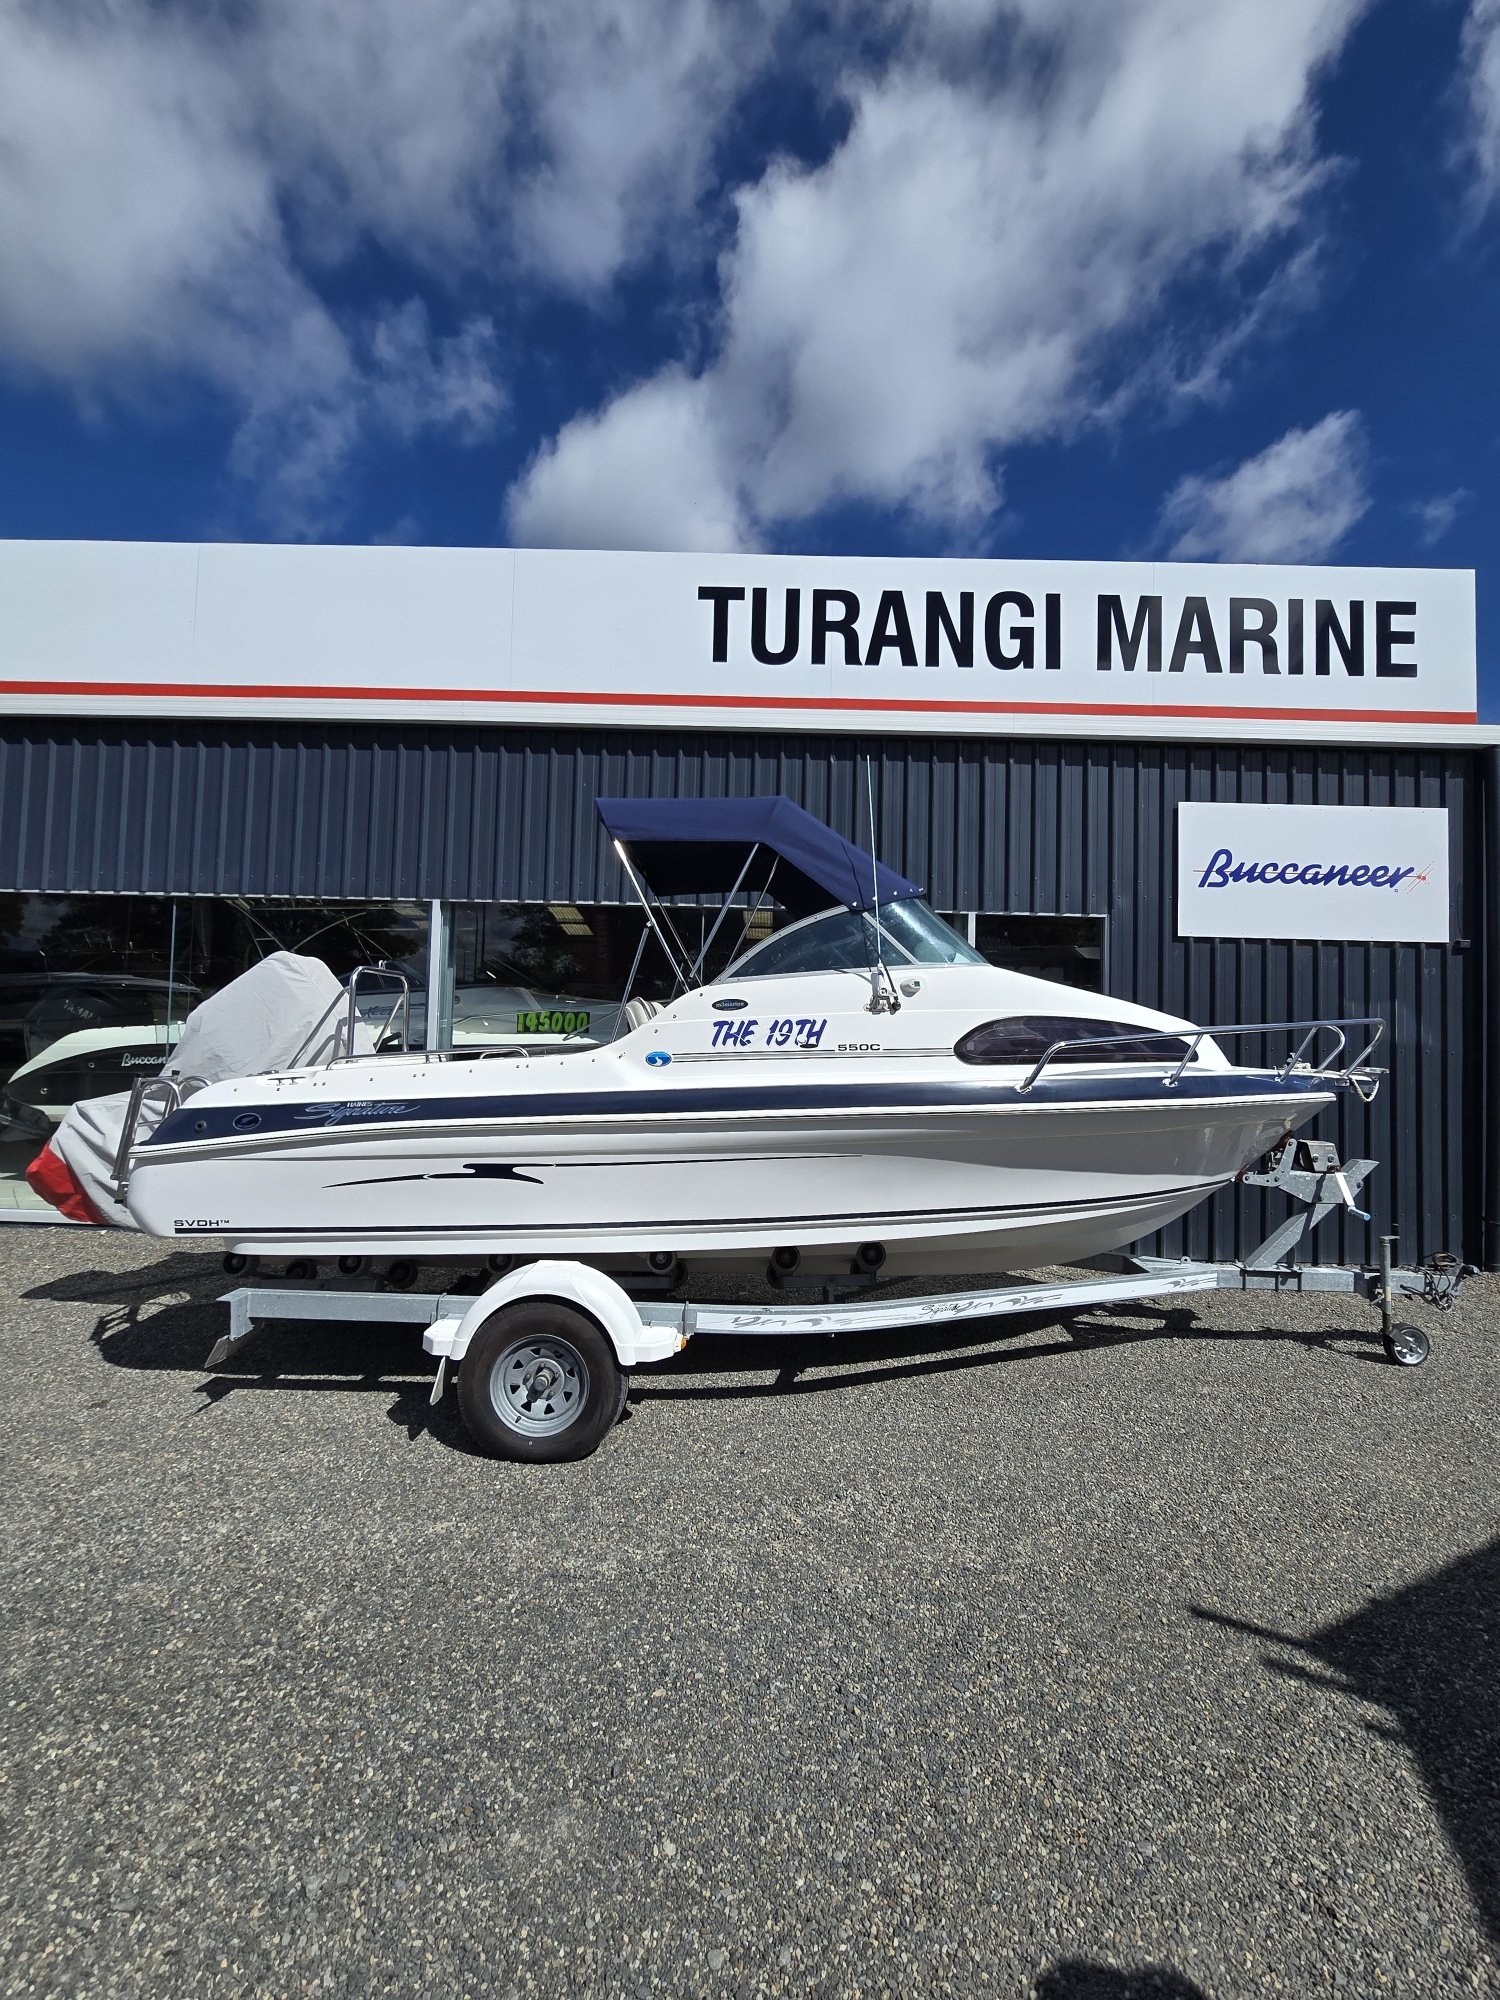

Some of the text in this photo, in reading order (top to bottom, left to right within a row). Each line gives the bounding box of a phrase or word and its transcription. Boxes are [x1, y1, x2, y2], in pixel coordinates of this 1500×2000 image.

[698, 586, 1417, 678] TURANGI MARINE
[1198, 849, 1415, 888] Buccaneer
[711, 1018, 828, 1048] THE 19TH
[121, 1052, 168, 1067] Buccan
[837, 1043, 881, 1051] 550C
[293, 1102, 421, 1127] Signature
